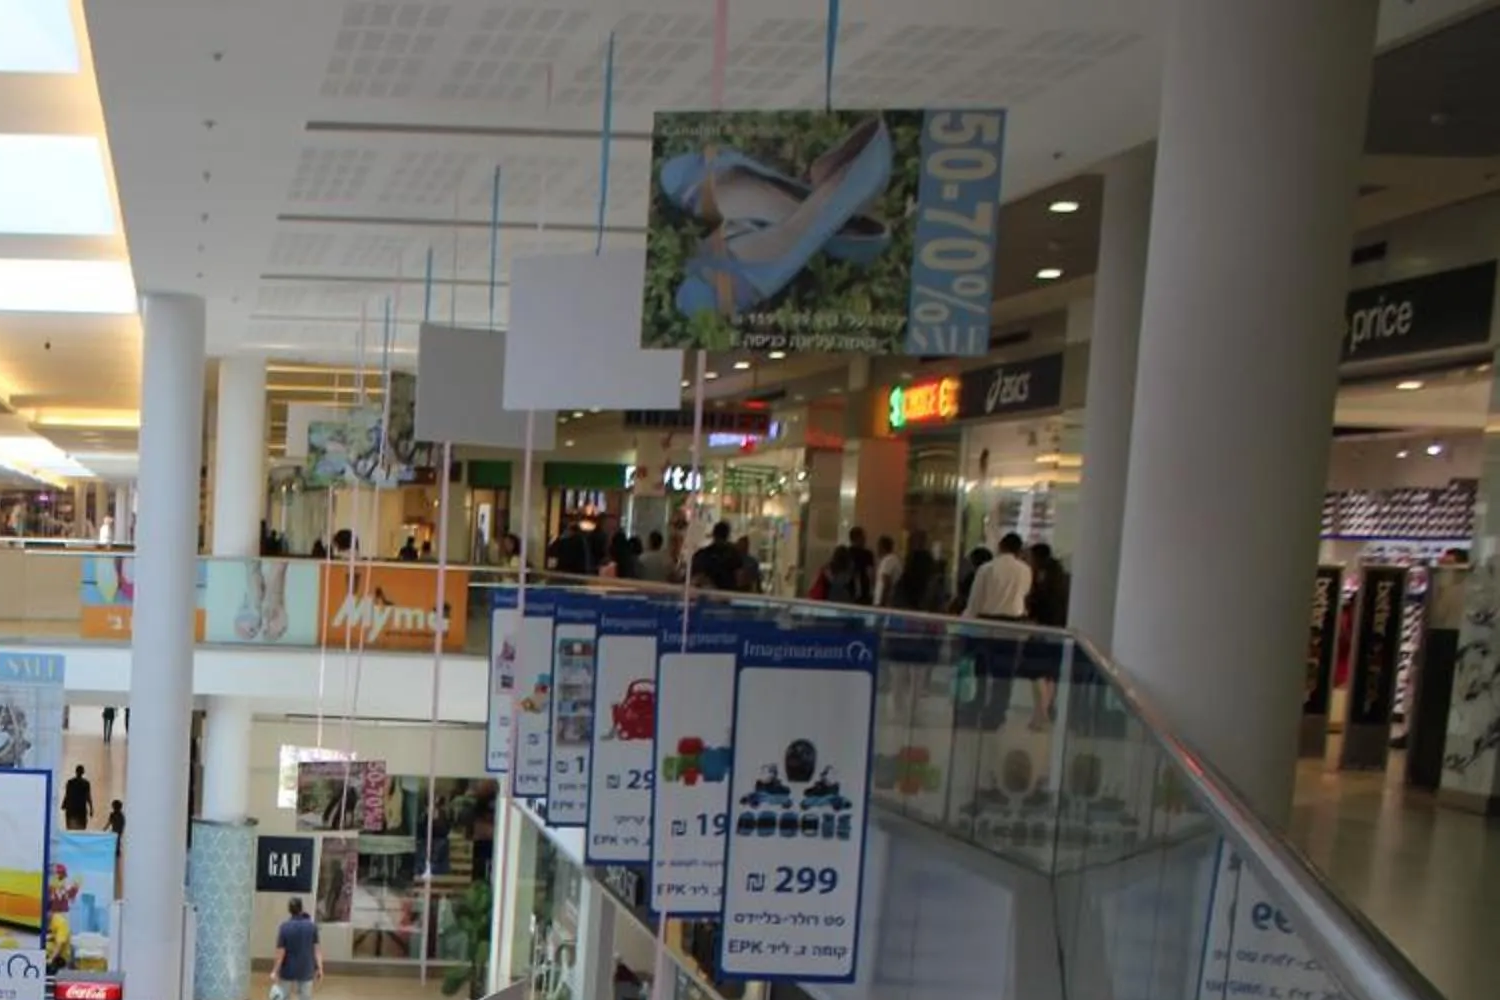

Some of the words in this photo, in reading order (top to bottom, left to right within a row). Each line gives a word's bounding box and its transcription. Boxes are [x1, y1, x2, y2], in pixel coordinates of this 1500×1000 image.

[912, 111, 1002, 326] 50-70%
[1350, 295, 1413, 354] price
[624, 466, 702, 491] Dlta
[268, 852, 301, 876] GAP
[775, 866, 838, 894] 299
[728, 939, 763, 954] EPK
[812, 945, 848, 959] קומה
